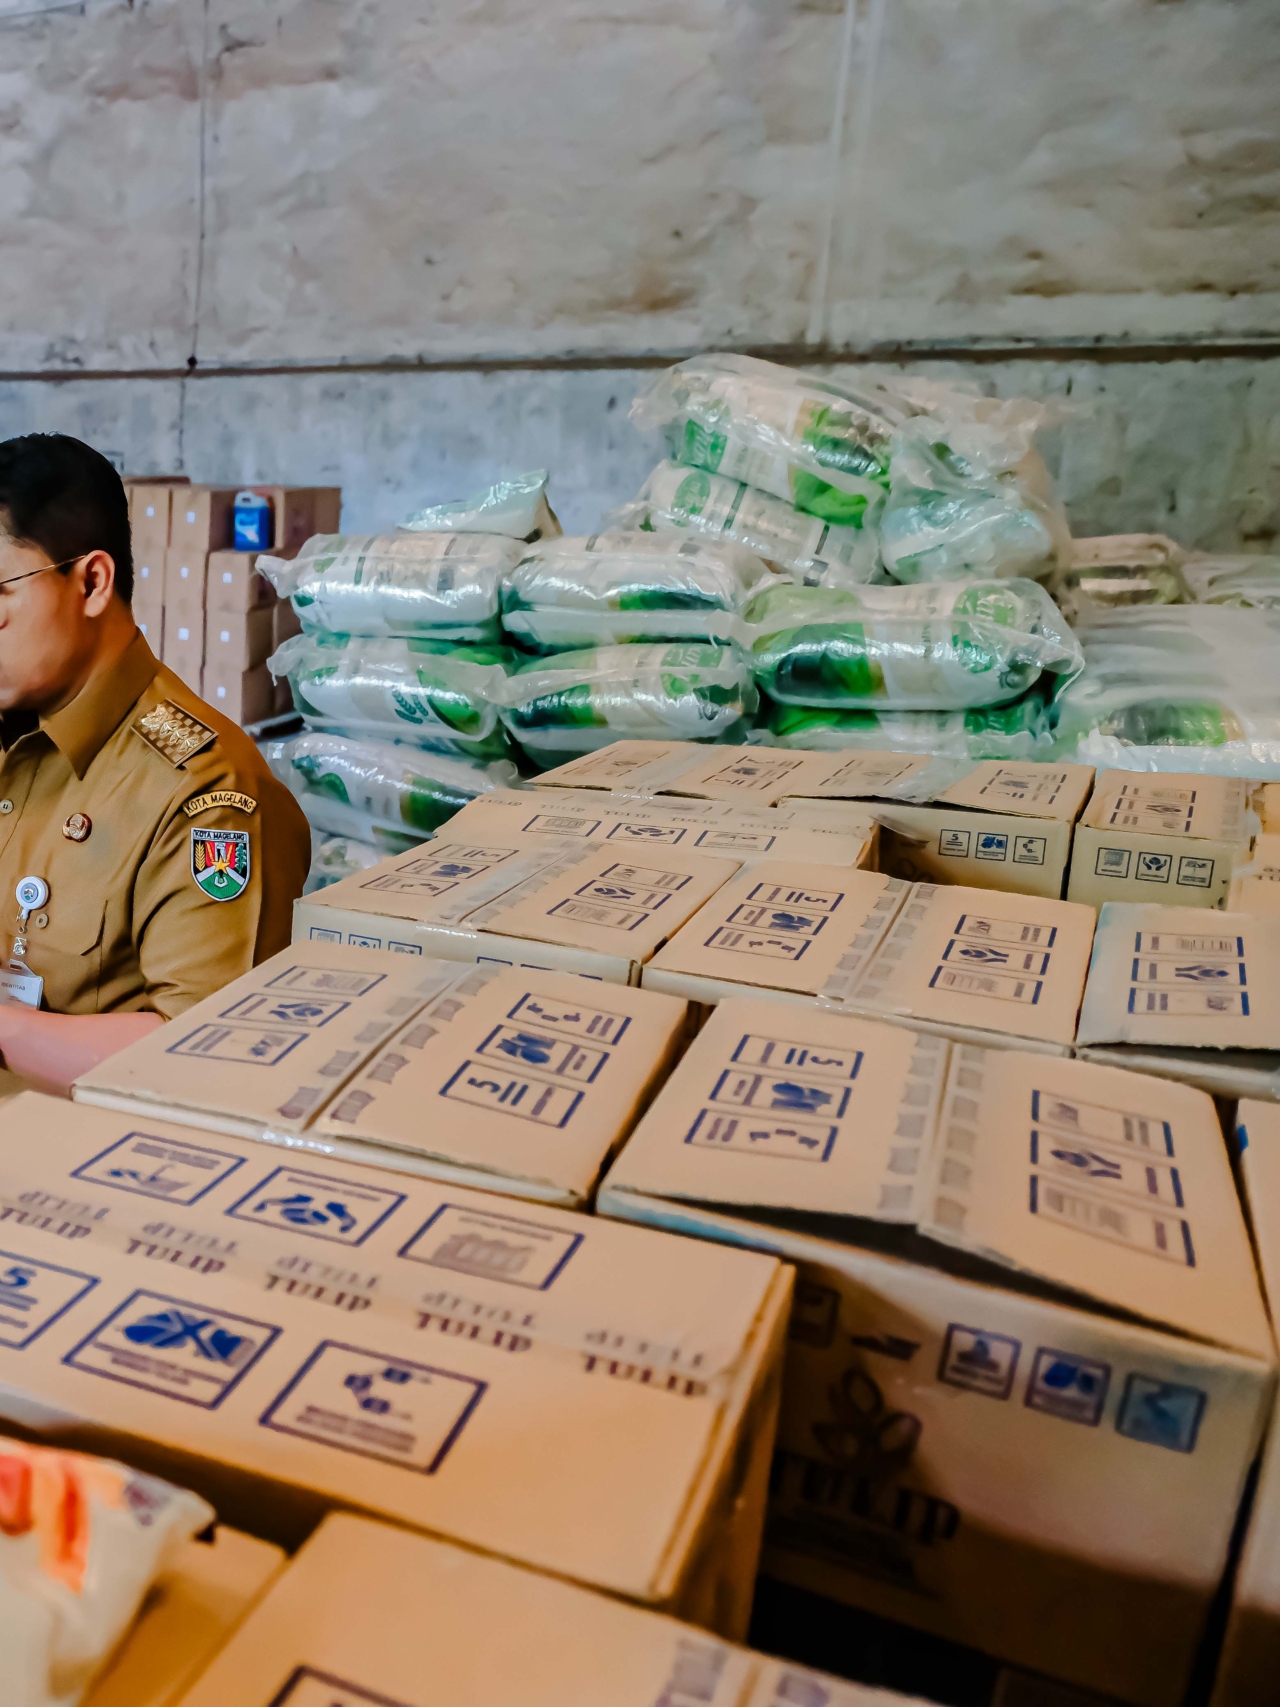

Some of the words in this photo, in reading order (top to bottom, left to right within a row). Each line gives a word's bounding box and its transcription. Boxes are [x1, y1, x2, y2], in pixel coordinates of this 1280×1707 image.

[186, 797, 208, 813] KOTA
[210, 793, 254, 810] MAGELANG
[194, 830, 212, 838] KOTA
[213, 831, 246, 841] MAGELANG
[951, 833, 959, 841] 5
[124, 1237, 226, 1274] TULIP
[265, 1272, 373, 1313] TULIP
[415, 1309, 533, 1353] TULIP
[581, 1351, 709, 1398] TULIP
